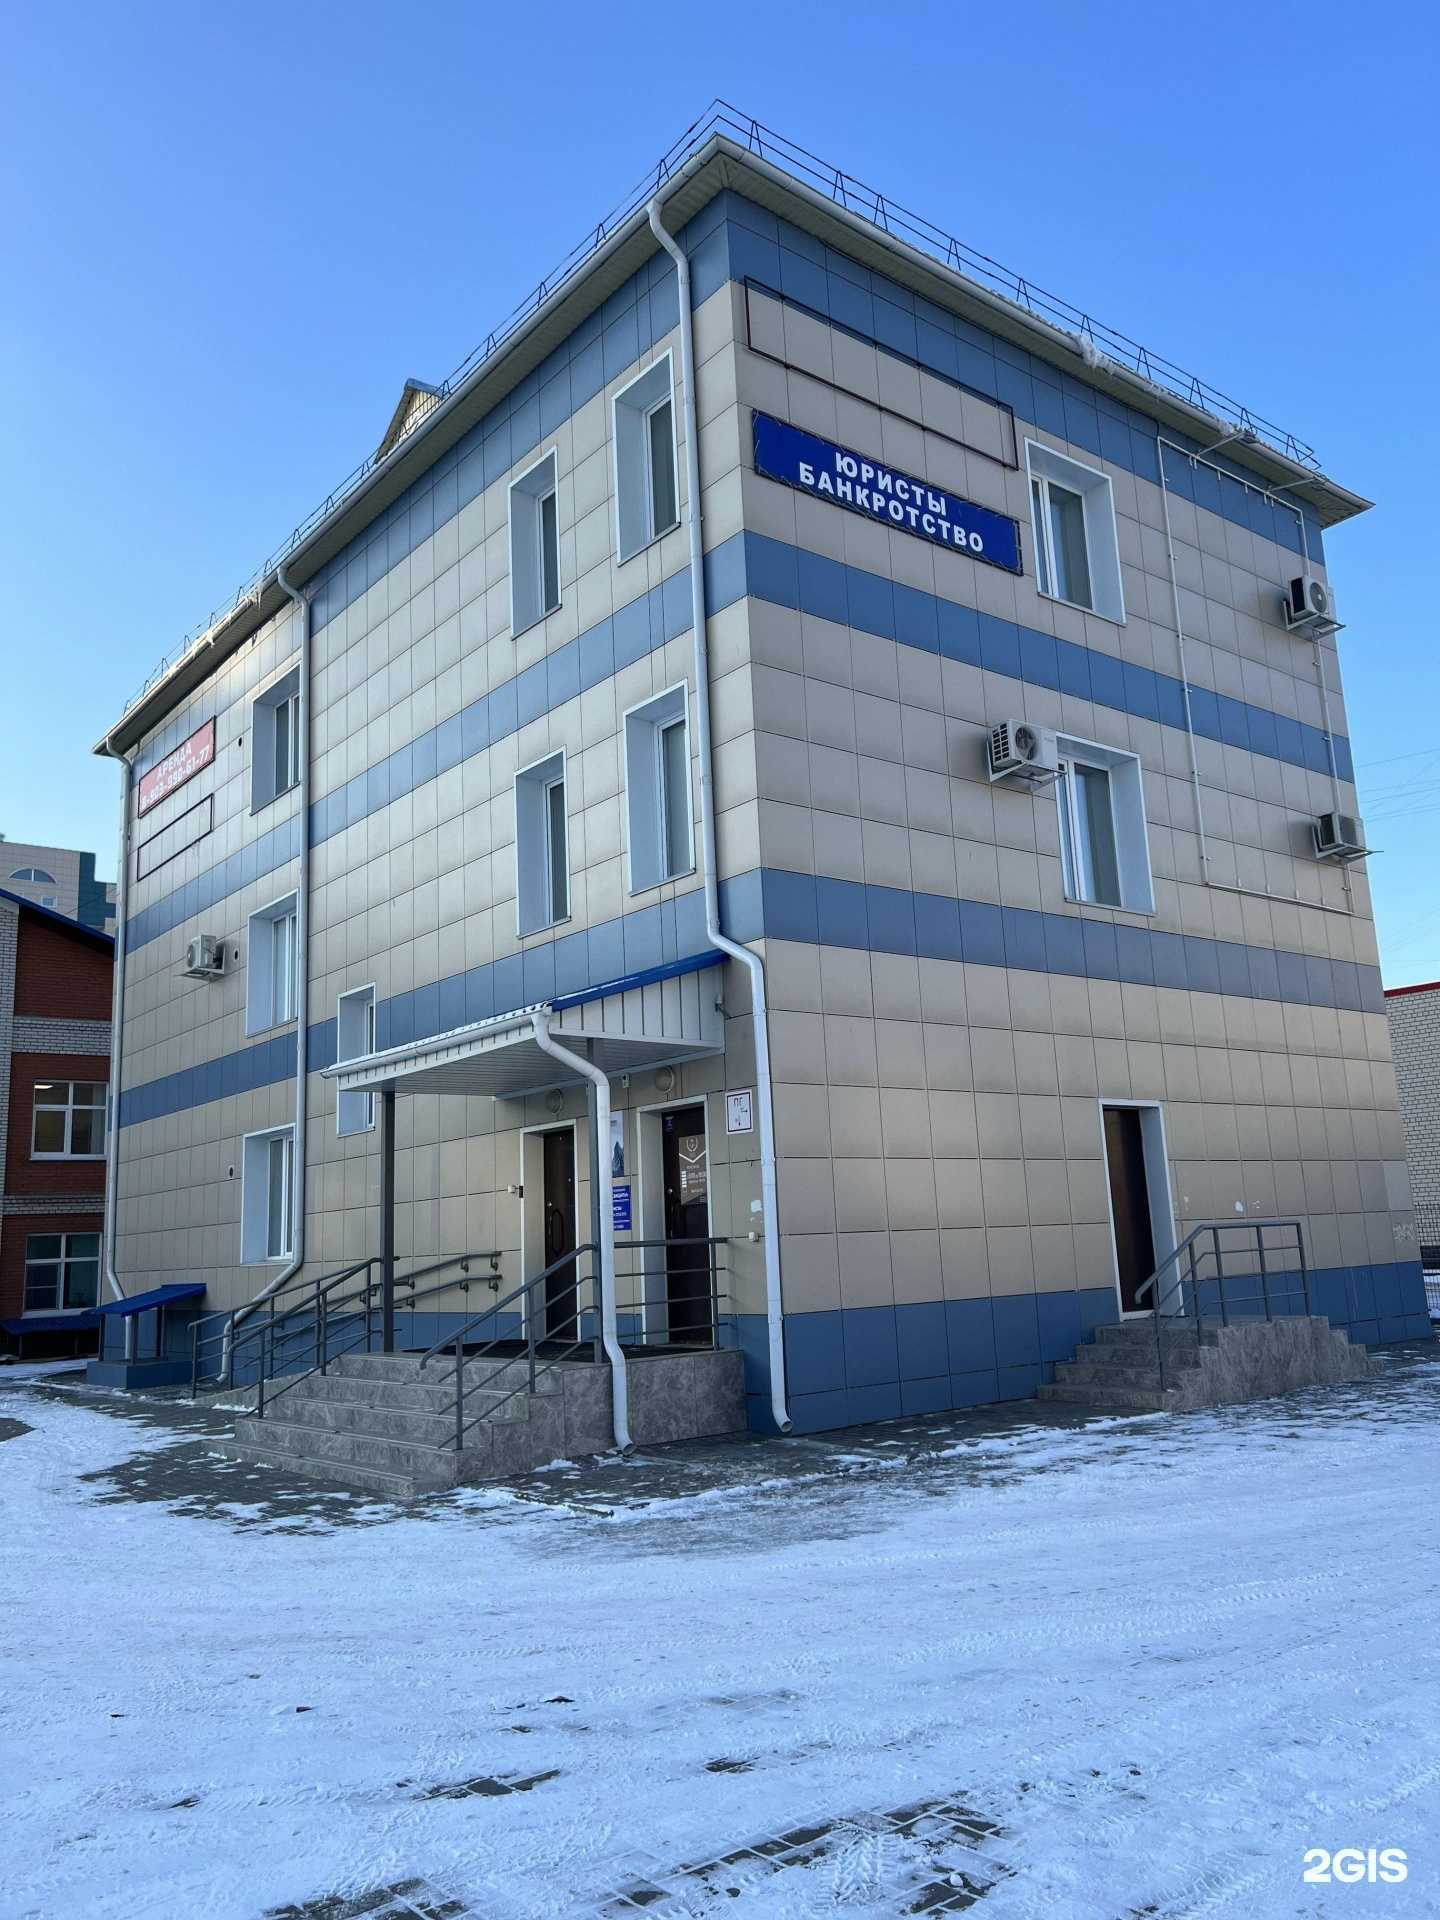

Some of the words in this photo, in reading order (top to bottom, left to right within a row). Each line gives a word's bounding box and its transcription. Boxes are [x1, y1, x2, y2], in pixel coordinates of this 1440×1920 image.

[799, 461, 984, 552] БАНКРОТСТВО
[835, 452, 947, 516] ЮРИСТЫ
[156, 742, 193, 781] АРЕНДА
